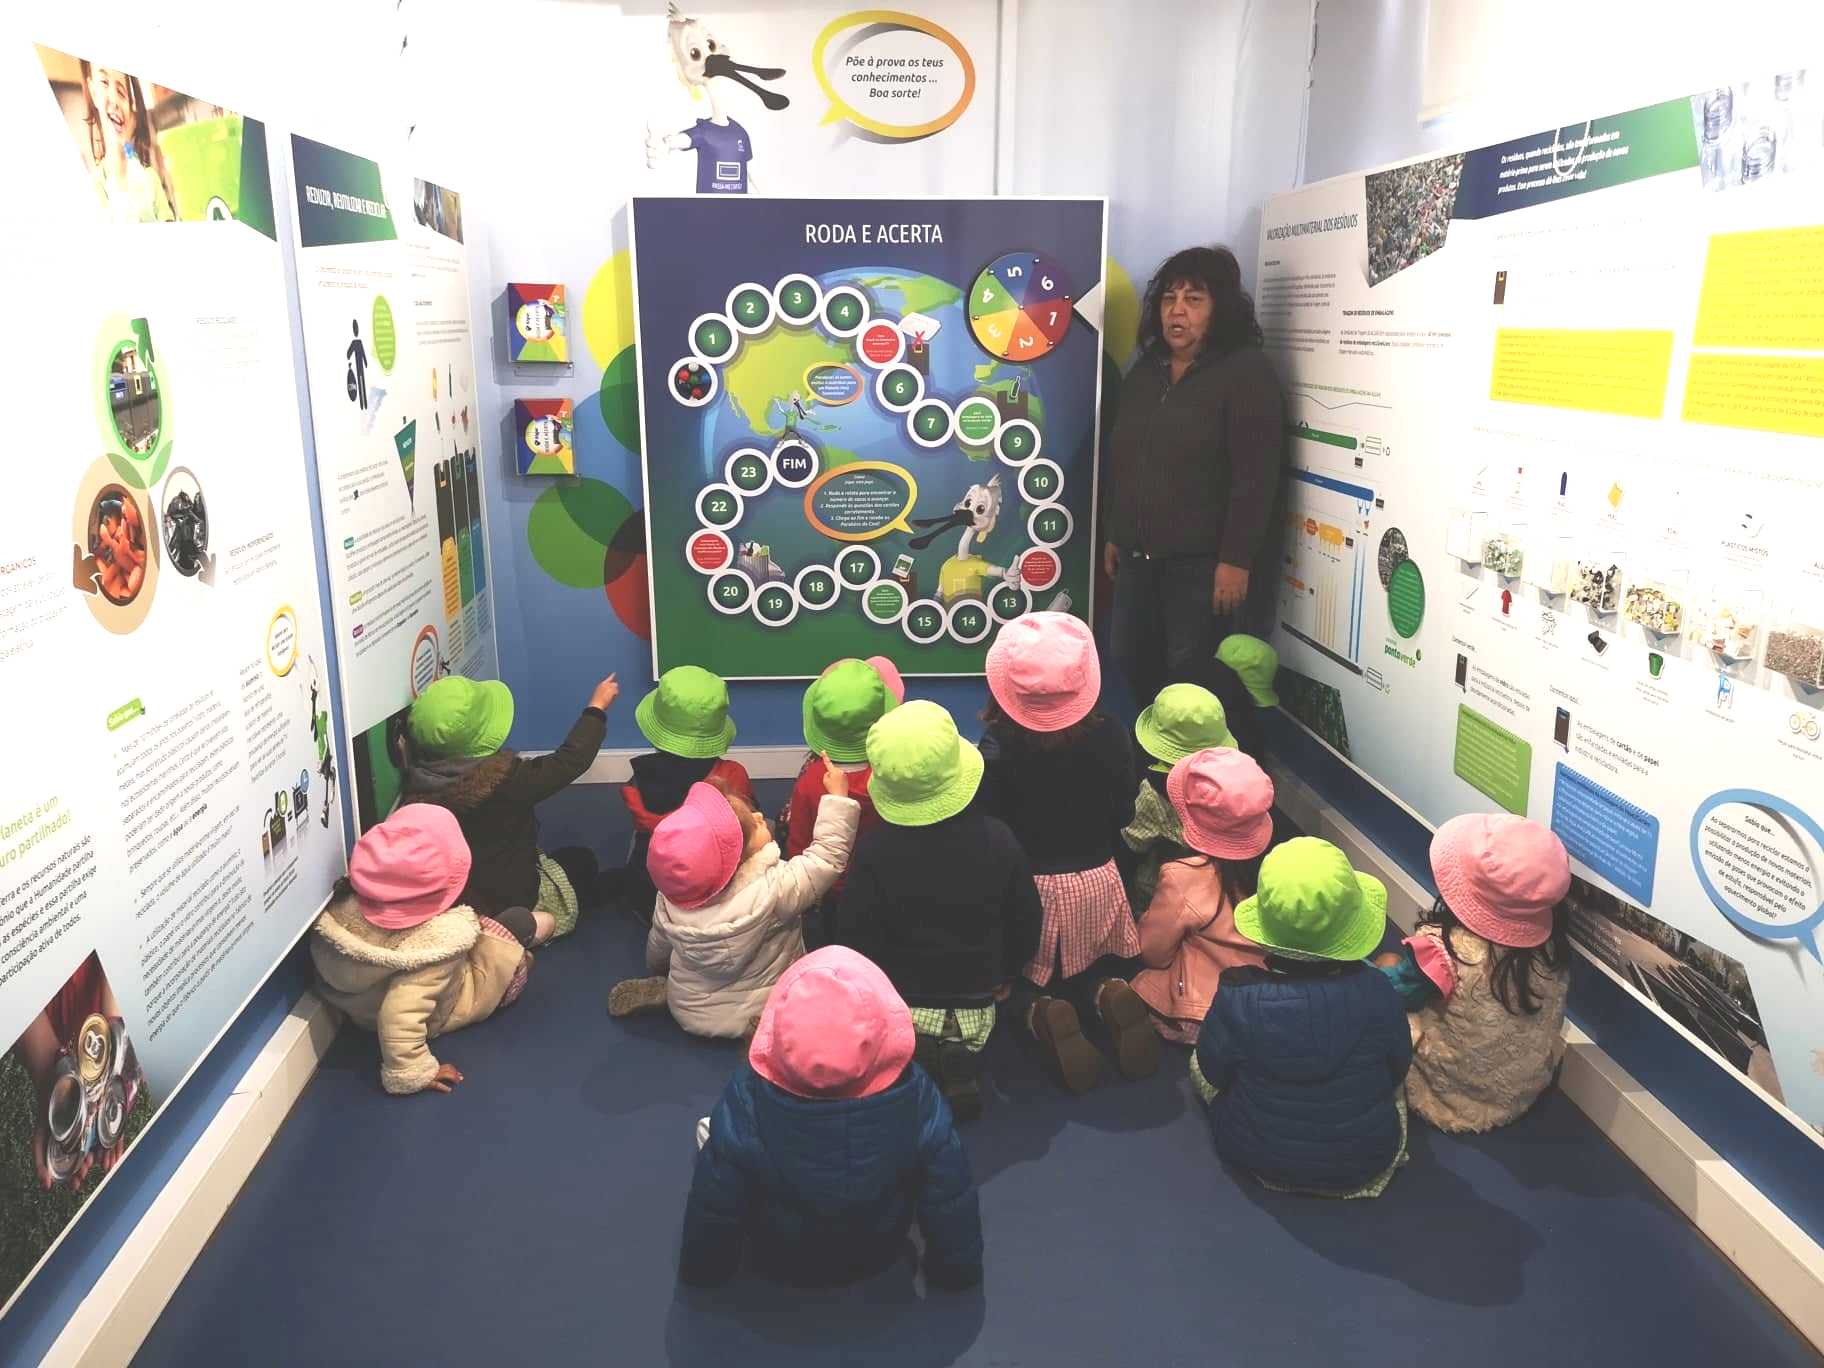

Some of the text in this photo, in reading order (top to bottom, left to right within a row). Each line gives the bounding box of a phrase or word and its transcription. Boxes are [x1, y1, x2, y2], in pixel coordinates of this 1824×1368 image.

[846, 56, 944, 69] Põe à prova os teus
[851, 72, 926, 83] conhecimentos
[870, 88, 921, 98] Boa sorte!
[805, 224, 943, 244] RODA E ACERTA
[1008, 266, 1022, 278] 5
[1042, 276, 1054, 290] 6
[793, 292, 802, 304] 3
[983, 288, 994, 303] 4
[746, 302, 754, 314] 2
[840, 306, 849, 317] 4
[708, 334, 716, 344] 1
[896, 383, 904, 394] 6
[928, 418, 936, 429] 7
[1014, 437, 1022, 448] 9
[782, 458, 807, 470] FIM
[740, 466, 756, 478] 23
[1034, 477, 1048, 488] 10
[710, 500, 728, 512] 22
[1043, 520, 1056, 530] 11
[850, 563, 864, 574] 17
[723, 586, 738, 597] 20
[809, 582, 824, 592] 18
[768, 599, 782, 609] 19
[1003, 598, 1016, 608] 13
[918, 616, 932, 626] 15
[962, 616, 976, 626] 14
[44, 794, 60, 813] um
[18, 810, 72, 859] partilhado!
[1760, 854, 1768, 863] de
[1781, 854, 1804, 868] estamos
[22, 880, 30, 892] os
[30, 860, 57, 886] recursos
[58, 844, 81, 866] naturais
[1724, 860, 1732, 868] de
[1746, 872, 1758, 884] que
[1750, 862, 1771, 878] energia
[16, 901, 28, 916] que
[34, 867, 72, 900] Humanidade
[72, 850, 94, 874] partilha
[12, 910, 39, 942] espécies
[45, 894, 59, 912] essa
[1, 928, 38, 964] consciência
[39, 902, 69, 935] ambiental
[38, 936, 54, 954] ativa
[54, 928, 62, 940] de
